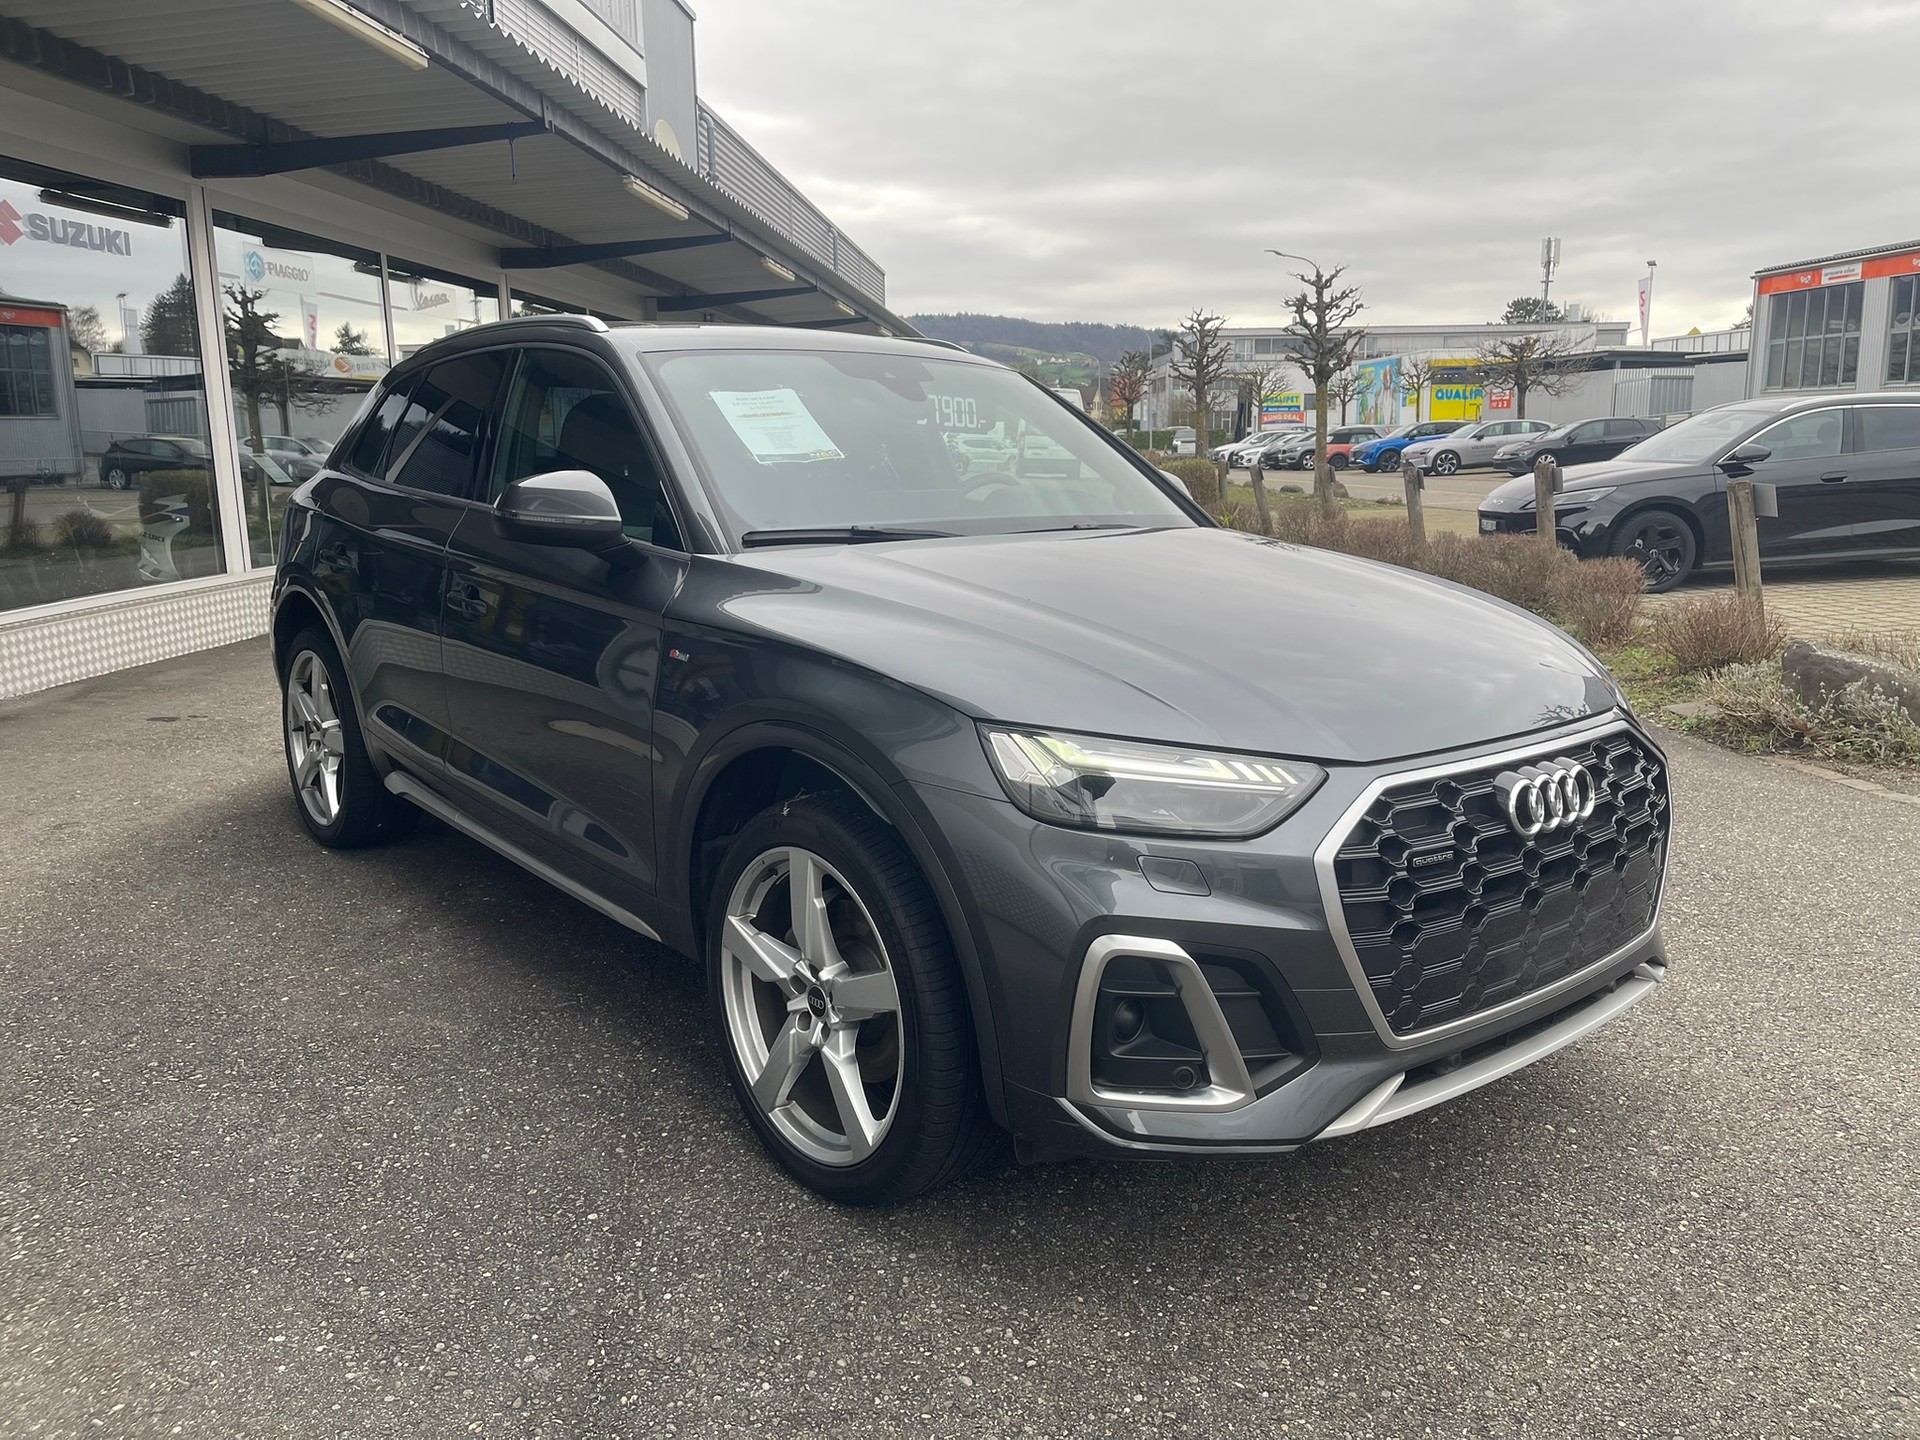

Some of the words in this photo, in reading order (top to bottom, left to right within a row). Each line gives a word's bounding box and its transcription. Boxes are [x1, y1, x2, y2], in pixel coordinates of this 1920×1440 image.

[28, 213, 131, 256] SUZUKI
[268, 263, 309, 282] PIAGGIO
[413, 284, 450, 311] Vespa
[1435, 388, 1483, 400] QUALIP
[1415, 853, 1453, 866] quattro
